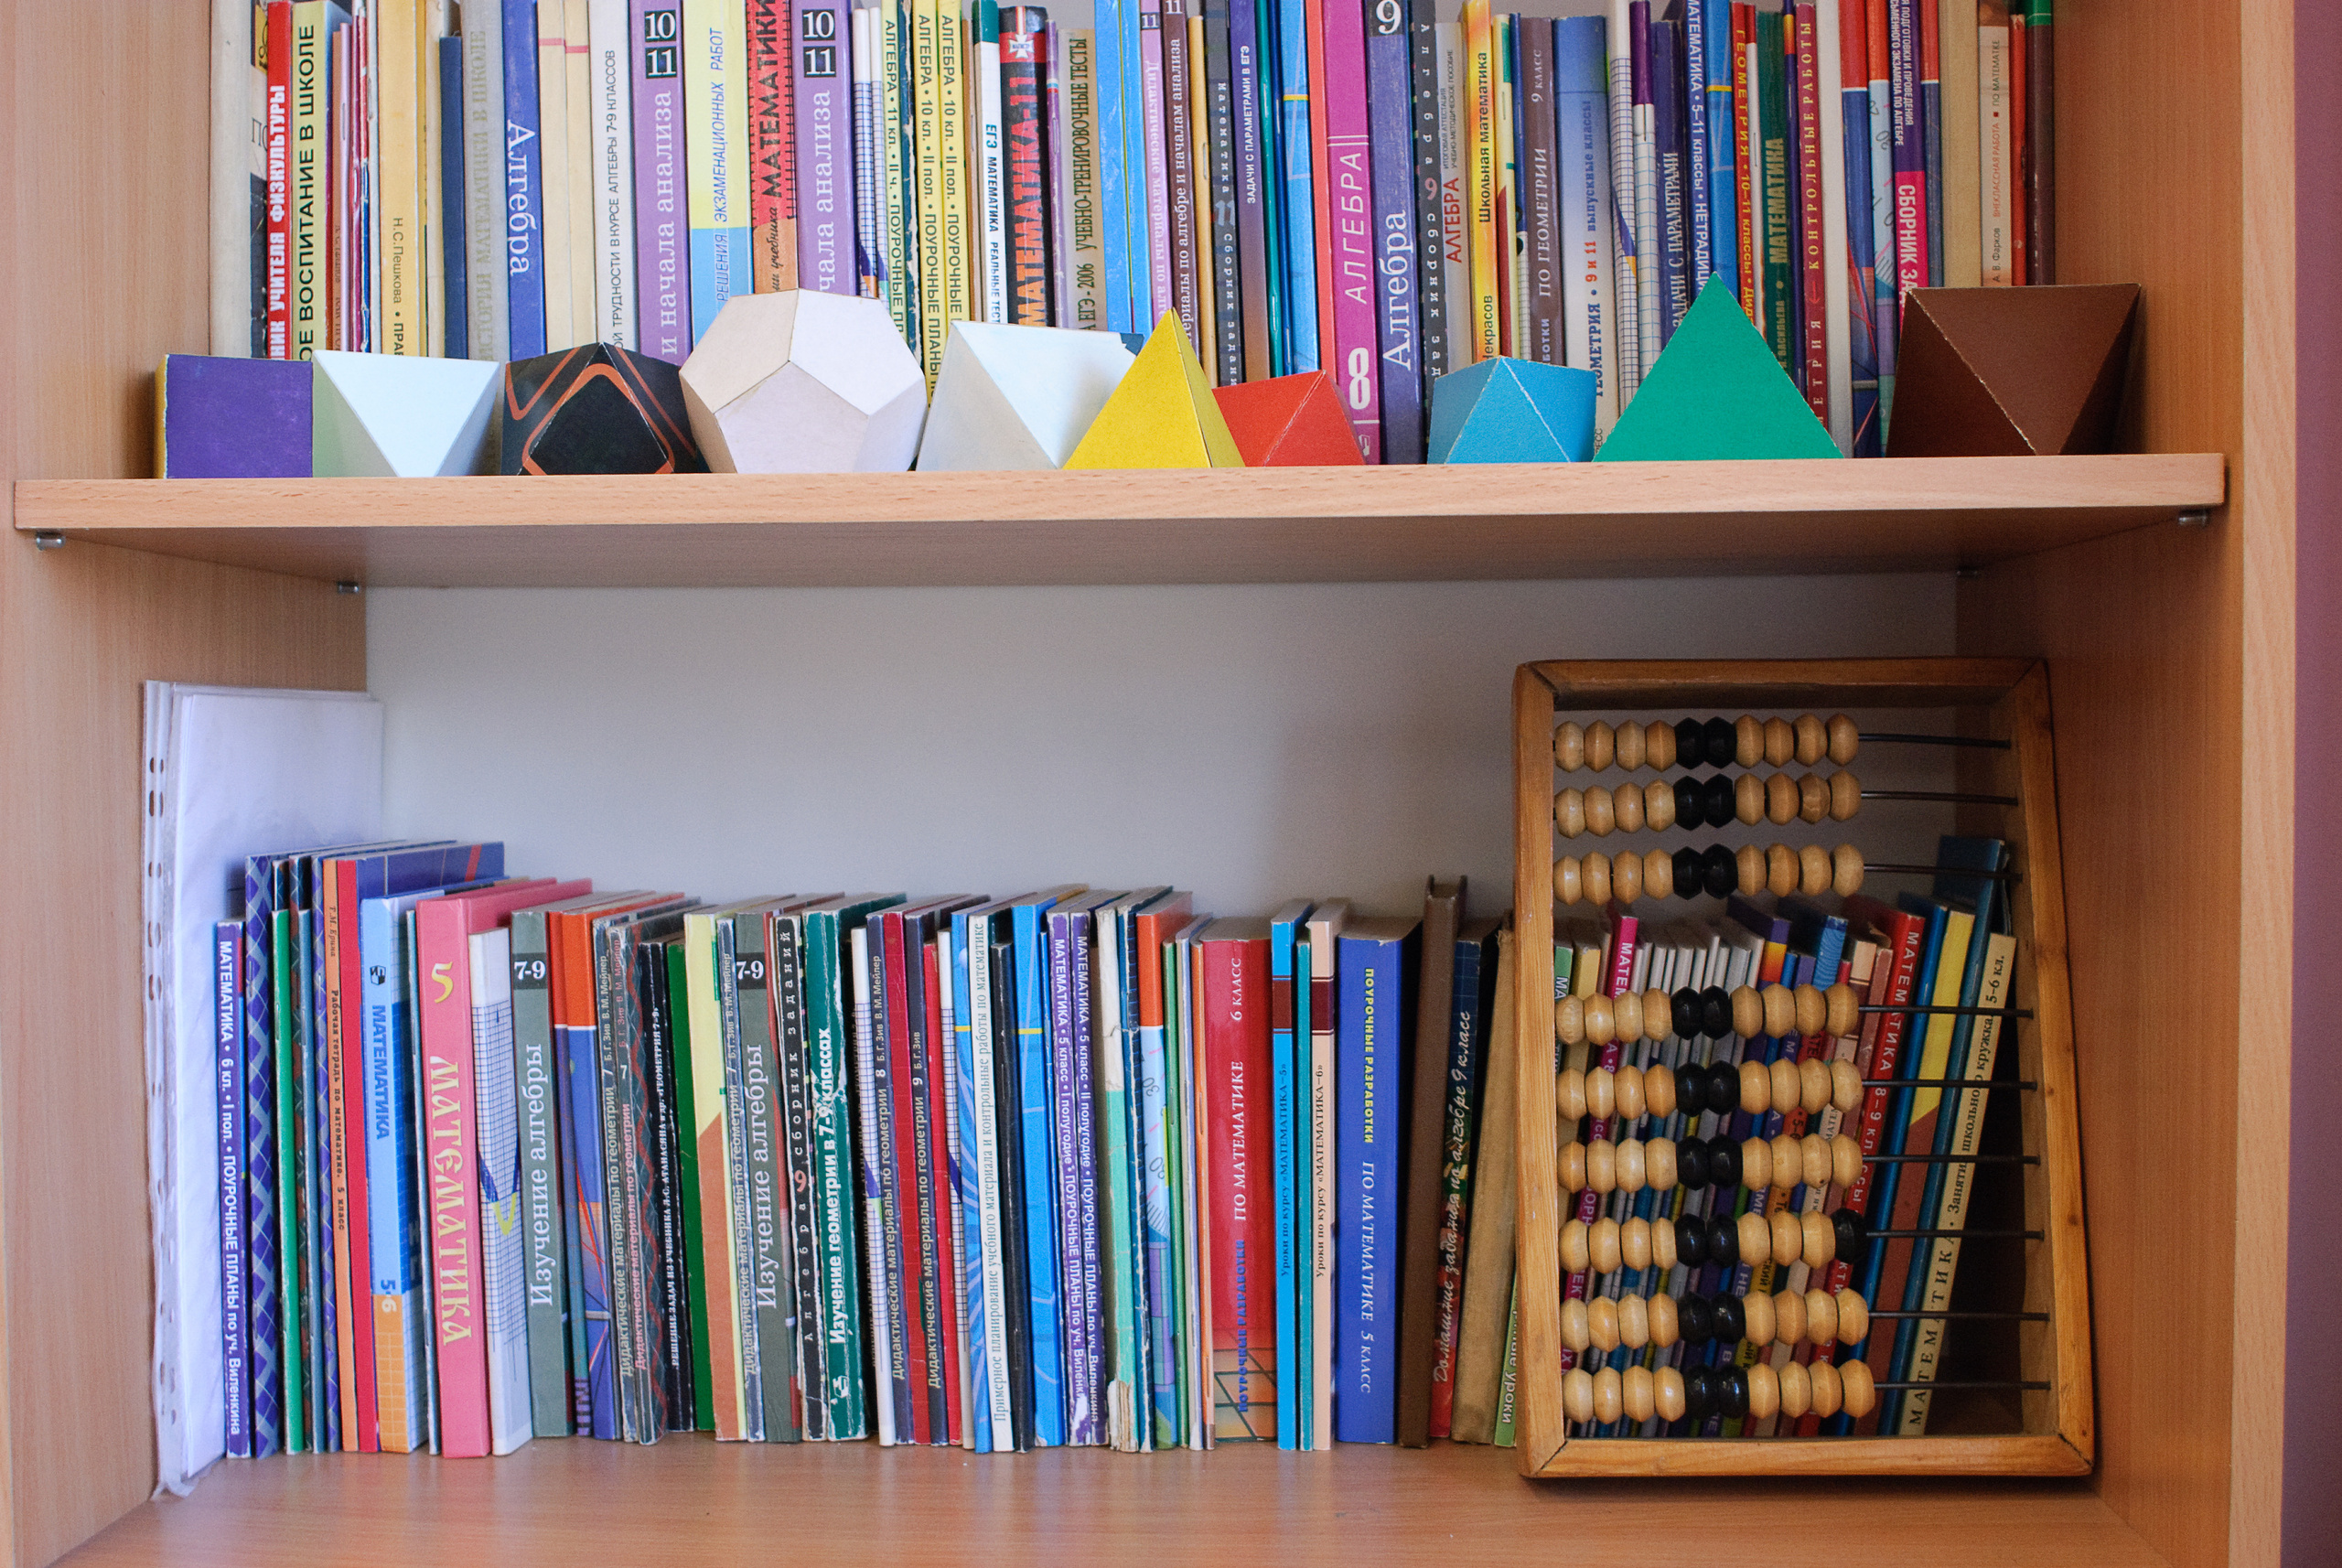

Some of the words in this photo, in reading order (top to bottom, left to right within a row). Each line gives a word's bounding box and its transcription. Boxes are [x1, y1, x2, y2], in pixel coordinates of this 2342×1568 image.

[646, 11, 677, 39] 10
[709, 27, 724, 72] РАБОТ
[802, 11, 834, 38] 10
[918, 15, 932, 85] АЛГЕБРА
[940, 15, 954, 86] АЛГЕБРА
[1375, 0, 1402, 35] 9
[1901, 6, 1912, 61] ПОДГОТОВКИ
[299, 24, 314, 115] ШКОЛЕ
[605, 49, 618, 110] КЛАССОВ
[647, 48, 677, 77] 11
[805, 48, 834, 76] 11
[885, 19, 898, 93] АЛГЕБРА
[1068, 38, 1089, 81] ТЕСТЫ
[1171, 38, 1183, 101] анализа
[1240, 46, 1251, 66] ЕГЭ
[1445, 48, 1456, 83] ПОСОБИЕ
[1799, 23, 1815, 104] РАБОТЫ
[1891, 49, 1902, 95] ЭКЗАМЕНА
[756, 0, 782, 198] МАТЕМАТИКИ
[1241, 76, 1255, 152] ПАРАМЕТРАМИ
[1447, 83, 1458, 170] УЧЕБНО-МЕТОДИЧЕСКОЕ
[1475, 52, 1489, 144] математика
[1736, 29, 1750, 156] ГЕОМЕТРИЯ
[1893, 108, 1905, 146] АЛГЕБРЕ
[1903, 70, 1915, 125] ПРОВЕДЕНИЯ
[269, 84, 286, 222] ФИЗКУЛЬТУРЫ
[607, 135, 620, 194] АЛГЕБРЫ
[655, 91, 674, 213] анализа
[710, 82, 727, 223] ЭКЗАМЕНАЦИОННЫХ
[813, 90, 834, 212] анализа
[985, 124, 998, 149] ЕГЭ
[1069, 83, 1097, 252] УЧЕБНО-ТРЕНИРОВОЧНЫЕ
[1173, 103, 1187, 169] началам
[1692, 138, 1704, 191] классы
[1992, 122, 2001, 156] РАБОТА
[507, 120, 538, 277] Алгебра
[923, 169, 934, 200] пол.
[946, 168, 956, 200] пол.
[987, 156, 999, 233] МАТЕМАТИКА
[1175, 187, 1189, 246] алгебре
[1217, 82, 1230, 194] Математика
[1224, 233, 1236, 311] Сборник
[1245, 164, 1258, 204] ЗАДАЧИ
[1477, 146, 1491, 223] Школьная
[1533, 146, 1550, 263] ГЕОМЕТРИИ
[1583, 152, 1598, 232] выпускные
[1662, 152, 1684, 252] ПАРАМЕТРАМИ
[1741, 172, 1751, 215] 10–11
[1765, 137, 1789, 263] МАТЕМАТИКА
[1802, 111, 1819, 270] КОНТРОЛЬНЫЕ
[1992, 156, 2001, 218] ВНЕКЛАССНАЯ
[299, 148, 314, 321] ВОСПИТАНИЕ
[1338, 152, 1368, 305] АЛГЕБРА
[1442, 177, 1463, 263] АЛГЕБРА
[1742, 218, 1753, 274] классы
[1897, 184, 1918, 264] СБОРНИК
[1992, 227, 2003, 261] Фарков
[270, 232, 285, 312] УЧИТЕЛЯ
[392, 217, 404, 305] Н.С.Пешкова
[608, 252, 623, 327] ТРУДНОСТИ
[658, 220, 679, 330] начала
[714, 234, 729, 302] РЕШЕНИЯ
[889, 205, 904, 307] ПОУРОЧНЫЕ
[924, 214, 939, 313] ПОУРОЧНЫЕ
[947, 213, 962, 313] ПОУРОЧНЫЕ
[990, 242, 1001, 297] РЕАЛЬНЫЕ
[1076, 263, 1096, 288] 2006
[1378, 210, 1413, 371] Алгебра
[1537, 268, 1552, 297] ПО
[1077, 299, 1096, 321] ЕГЭ
[661, 336, 679, 355] и
[1348, 347, 1370, 411] 8
[220, 940, 233, 1042] МАТЕМАТИКА
[780, 931, 796, 1036] заданий
[973, 922, 986, 991] математике
[1055, 938, 1068, 1026] МАТЕМАТИКА
[1076, 935, 1089, 1023] МАТЕМАТИКА
[1230, 958, 1243, 1006] КЛАСС
[1992, 955, 2005, 976] кл.
[330, 989, 341, 1035] Рабочая
[1363, 967, 1375, 1053] ПОУРОЧНЫЕ
[1985, 980, 2001, 1004] 5–6
[332, 1037, 341, 1083] тетрадь
[818, 1027, 832, 1098] классах
[876, 1023, 886, 1062] Б.Г.Зив
[911, 1031, 923, 1069] Б.Г.Зив
[976, 1012, 991, 1055] работы
[1058, 1047, 1069, 1082] класс
[1080, 1044, 1090, 1080] класс
[1456, 1010, 1471, 1067] класс
[1974, 1015, 1996, 1070] кружка.
[371, 1004, 391, 1140] МАТЕМАТИКА
[520, 1044, 550, 1162] алгебры
[744, 1045, 772, 1163] алгебры
[788, 1051, 803, 1155] сборник
[978, 1058, 994, 1135] контрольные
[1363, 1056, 1374, 1144] РАЗРАБОТКИ
[1451, 1069, 1467, 1081] 9
[1869, 1086, 1887, 1122] 8–9
[222, 1112, 234, 1143] пол.
[334, 1106, 343, 1178] математике.
[605, 1087, 621, 1163] геометрии
[659, 1123, 670, 1183] АТАНАСЯНА
[877, 1088, 893, 1164] геометрии
[914, 1097, 929, 1173] геометрии
[1059, 1099, 1071, 1165] полугодие
[1079, 1101, 1091, 1168] полугодие
[1231, 1060, 1246, 1189] МАТЕМАТИКЕ
[1448, 1084, 1469, 1163] алгебре
[224, 1155, 238, 1251] ПОУРОЧНЫЕ
[429, 1056, 473, 1347] МАТЕМАТИКА
[823, 1155, 843, 1252] геометрии
[983, 1151, 997, 1210] материала
[1233, 1194, 1247, 1222] ПО
[1281, 1185, 1291, 1220] курсу
[1316, 1187, 1326, 1221] курсу
[1449, 1166, 1462, 1189] по
[337, 1198, 345, 1230] класс
[527, 1169, 556, 1307] Изучение
[609, 1187, 627, 1266] материалы
[663, 1208, 675, 1262] УЧЕБНИКА
[752, 1169, 779, 1310] Изучение
[882, 1188, 897, 1269] материалы
[919, 1197, 934, 1277] материалы
[984, 1214, 1003, 1267] учебного
[1064, 1175, 1078, 1256] ПОУРОЧНЫЕ
[1083, 1178, 1097, 1261] ПОУРОЧНЫЕ
[1440, 1193, 1461, 1276] задания
[225, 1253, 240, 1308] ПЛАНЫ
[1069, 1259, 1081, 1307] ПЛАНЫ
[1085, 1263, 1098, 1313] ПЛАНЫ
[1235, 1240, 1248, 1326] РАЗРАБОТКИ
[1280, 1240, 1291, 1277] Уроки
[1316, 1240, 1326, 1279] Уроки
[1360, 1193, 1375, 1322] МАТЕМАТИКЕ
[616, 1269, 634, 1377] Дидактические
[667, 1281, 678, 1313] ЗАДАЧ
[828, 1253, 848, 1344] Изучение
[886, 1272, 905, 1380] Дидактические
[987, 1270, 1004, 1353] планирование
[1433, 1279, 1455, 1383] Домашние
[669, 1313, 680, 1367] РЕШЕНИЕ
[922, 1280, 941, 1389] Дидактические
[1359, 1345, 1372, 1394] КЛАСС
[229, 1358, 242, 1435] Виленкина
[990, 1356, 1008, 1422] Примерное
[1089, 1354, 1100, 1423] Виленкина
[1237, 1329, 1249, 1413] ПОУРОЧНЫЕ
[1501, 1371, 1517, 1424] уроки
